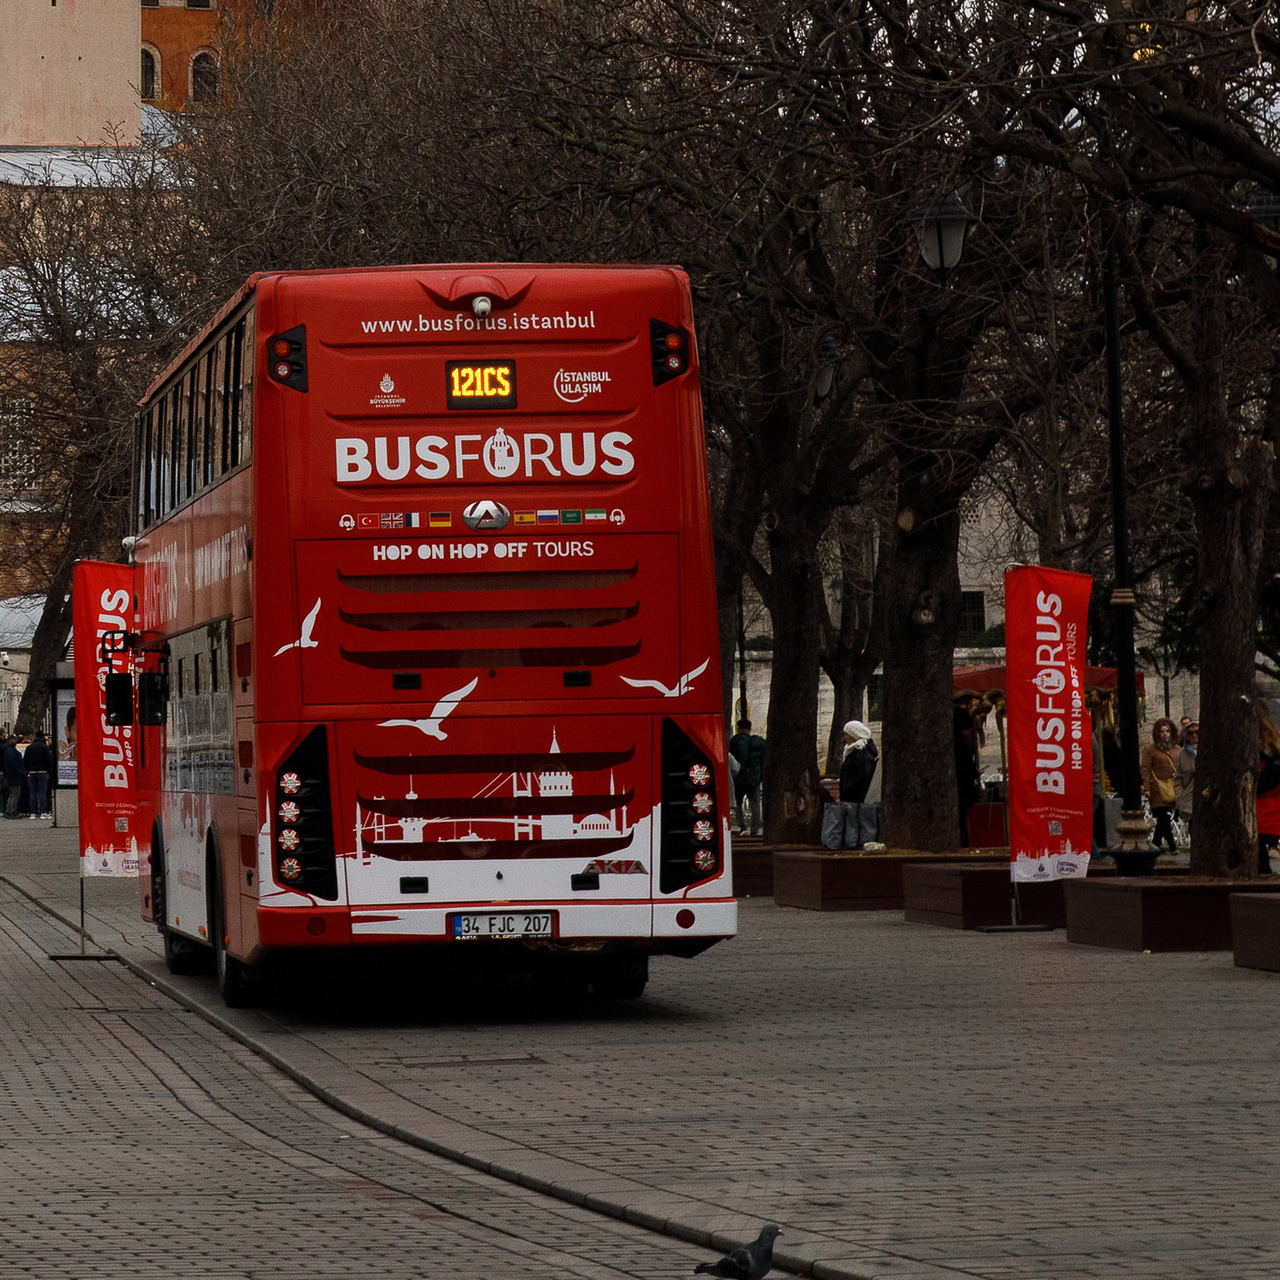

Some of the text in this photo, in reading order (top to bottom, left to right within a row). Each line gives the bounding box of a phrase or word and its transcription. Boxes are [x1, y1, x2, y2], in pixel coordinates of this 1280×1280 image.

[361, 310, 596, 333] www.busforus.istanbul
[451, 367, 510, 397] 121CS
[560, 368, 612, 382] İSTANBUL
[335, 428, 635, 482] BUSFORUS
[373, 541, 594, 561] HOP ON HOP OFF TOURS
[1035, 590, 1066, 796] BUSFORUS
[1066, 622, 1082, 770] HOP ON HOP OFF TOURS
[123, 740, 133, 767] HOP
[581, 859, 649, 875] AKIA
[462, 917, 480, 934] 34
[489, 916, 515, 933] FJC
[524, 915, 549, 932] 207
